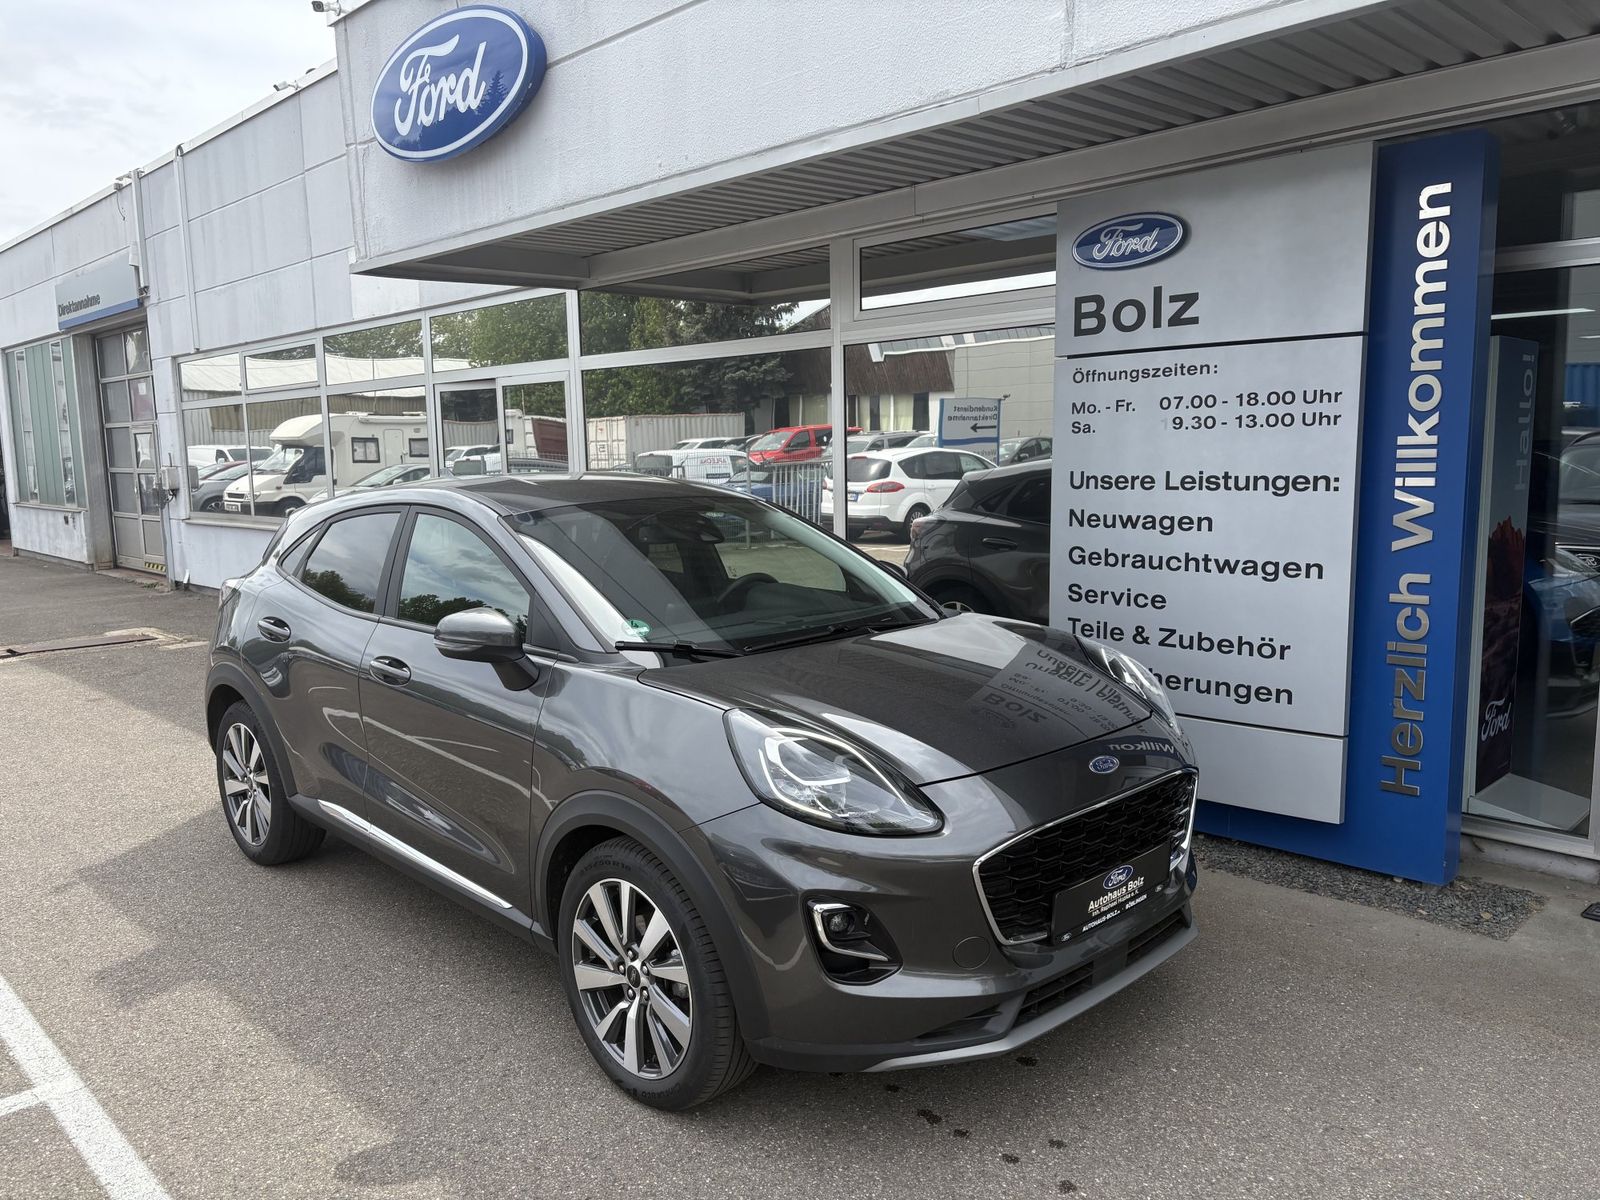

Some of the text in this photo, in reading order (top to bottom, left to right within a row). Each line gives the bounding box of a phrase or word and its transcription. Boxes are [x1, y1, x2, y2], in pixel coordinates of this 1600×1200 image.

[393, 33, 487, 137] Ford
[1092, 222, 1160, 260] Ford
[58, 294, 100, 317] Direktannahme
[1073, 286, 1200, 337] Bolz
[1072, 363, 1218, 384] Öffnungszeiten:
[1071, 401, 1101, 415] Mo.
[1115, 399, 1136, 413] Fr.
[1159, 394, 1217, 411] 07.00
[1236, 390, 1296, 407] 18.00
[1302, 389, 1342, 405] Uhr
[1071, 421, 1096, 434] Sa.
[1172, 415, 1217, 431] 9.30
[1235, 412, 1295, 429] 13.00
[1302, 411, 1342, 427] Uhr
[1069, 470, 1340, 497] Unsere Leistungen:
[1380, 182, 1452, 796] Herzlich Willkommen
[1068, 508, 1213, 536] Neuwagen
[1068, 545, 1324, 582] Gebrauchtwagen
[1068, 583, 1167, 610] Service
[1067, 617, 1291, 660] Teile & Zubehör
[1481, 697, 1512, 742] Ford
[1108, 868, 1128, 887] Ford
[1088, 885, 1127, 911] Autohaus
[1127, 876, 1145, 891] Bolz
